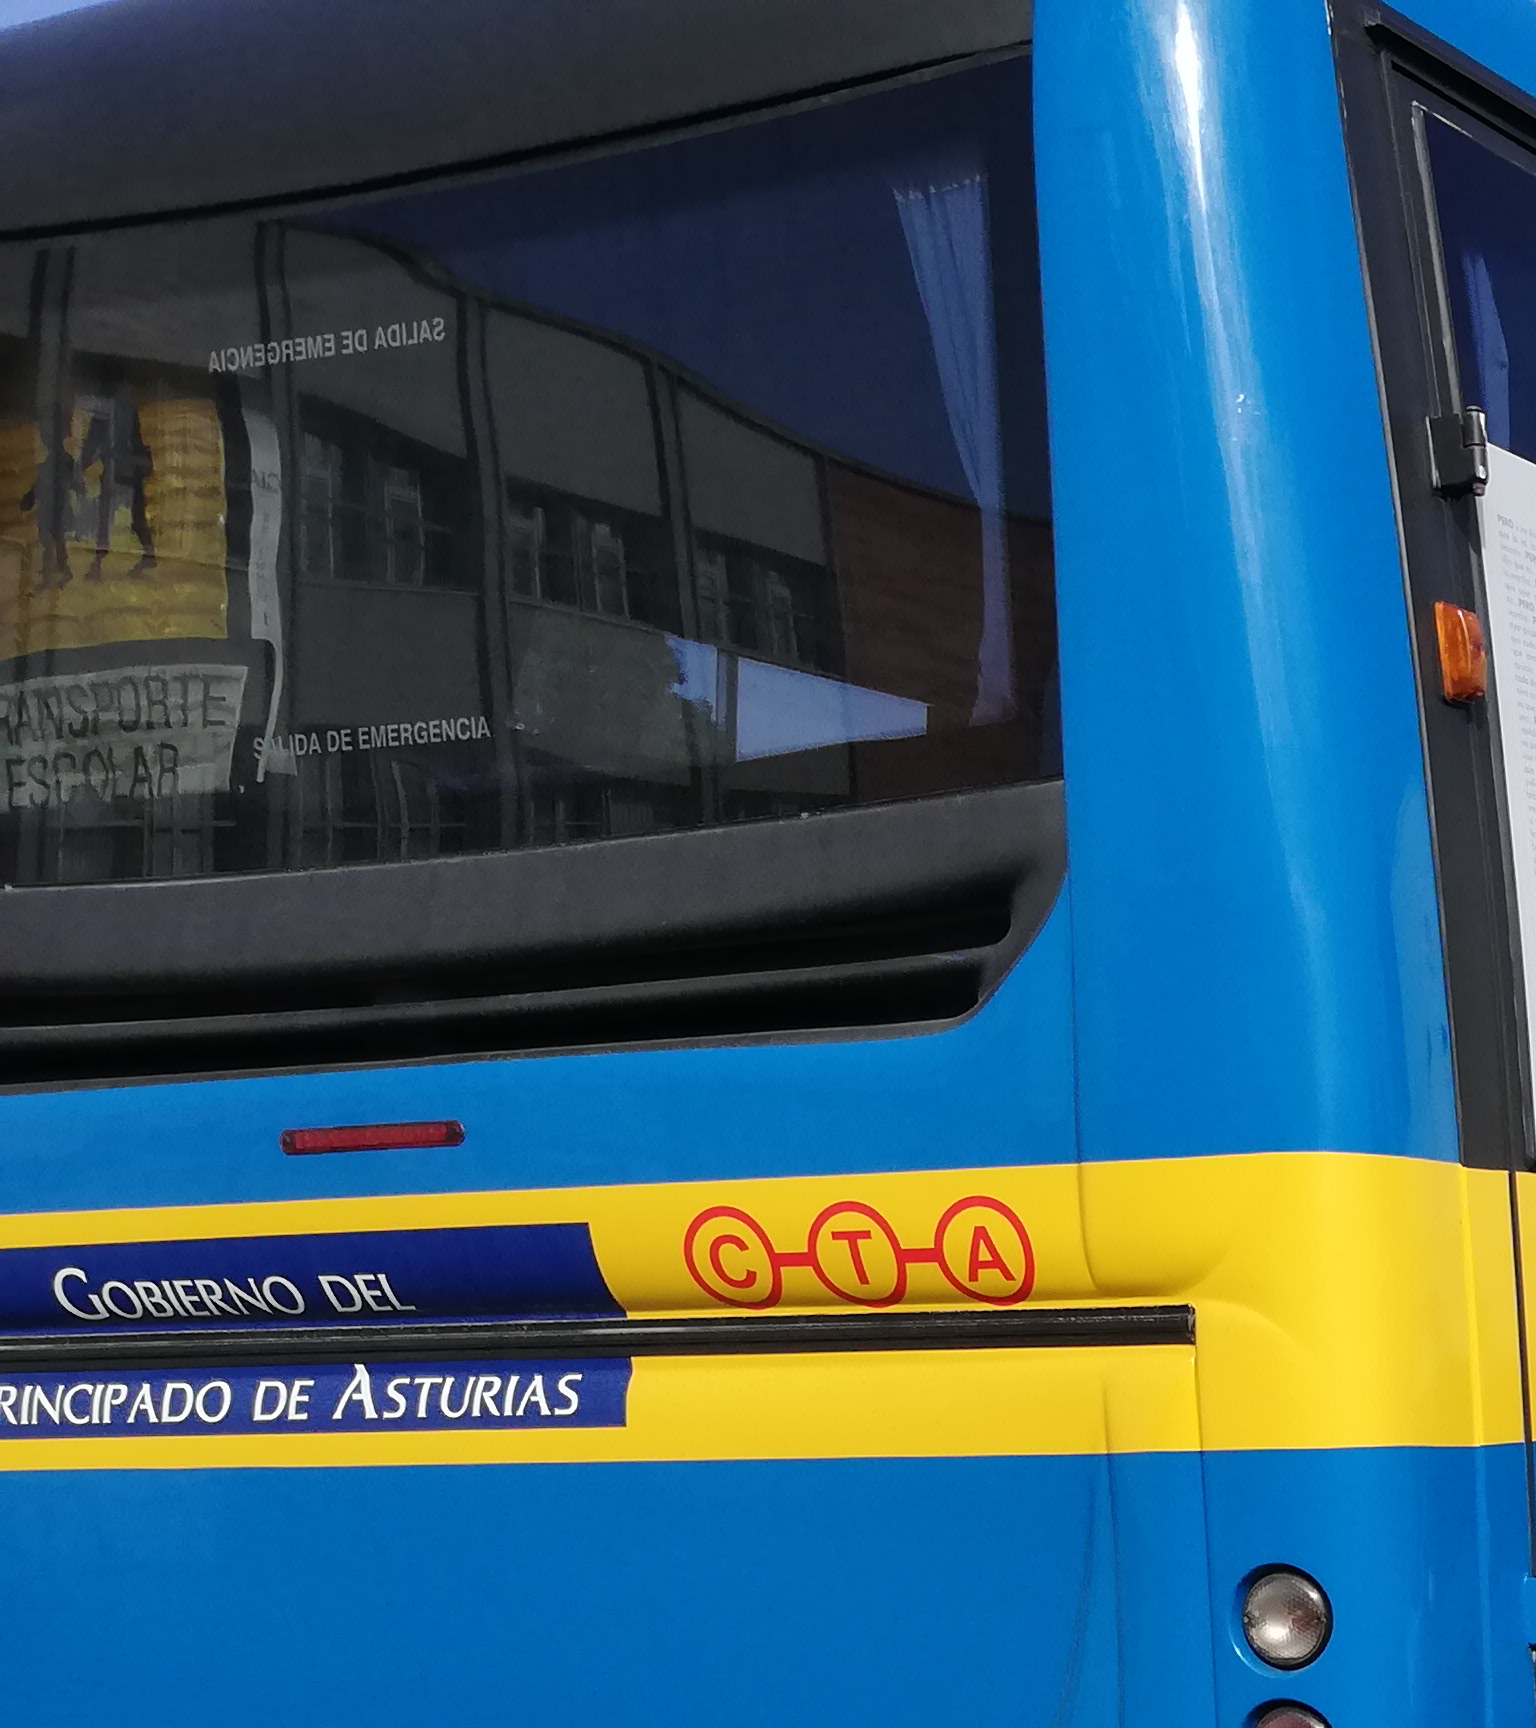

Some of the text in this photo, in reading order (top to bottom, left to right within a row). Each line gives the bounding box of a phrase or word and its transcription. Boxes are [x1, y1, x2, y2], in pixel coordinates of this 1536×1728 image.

[253, 716, 491, 760] SALIDA DE EMERGENCIA
[0, 1379, 232, 1425] RINCIPADO
[253, 1379, 315, 1423] DE
